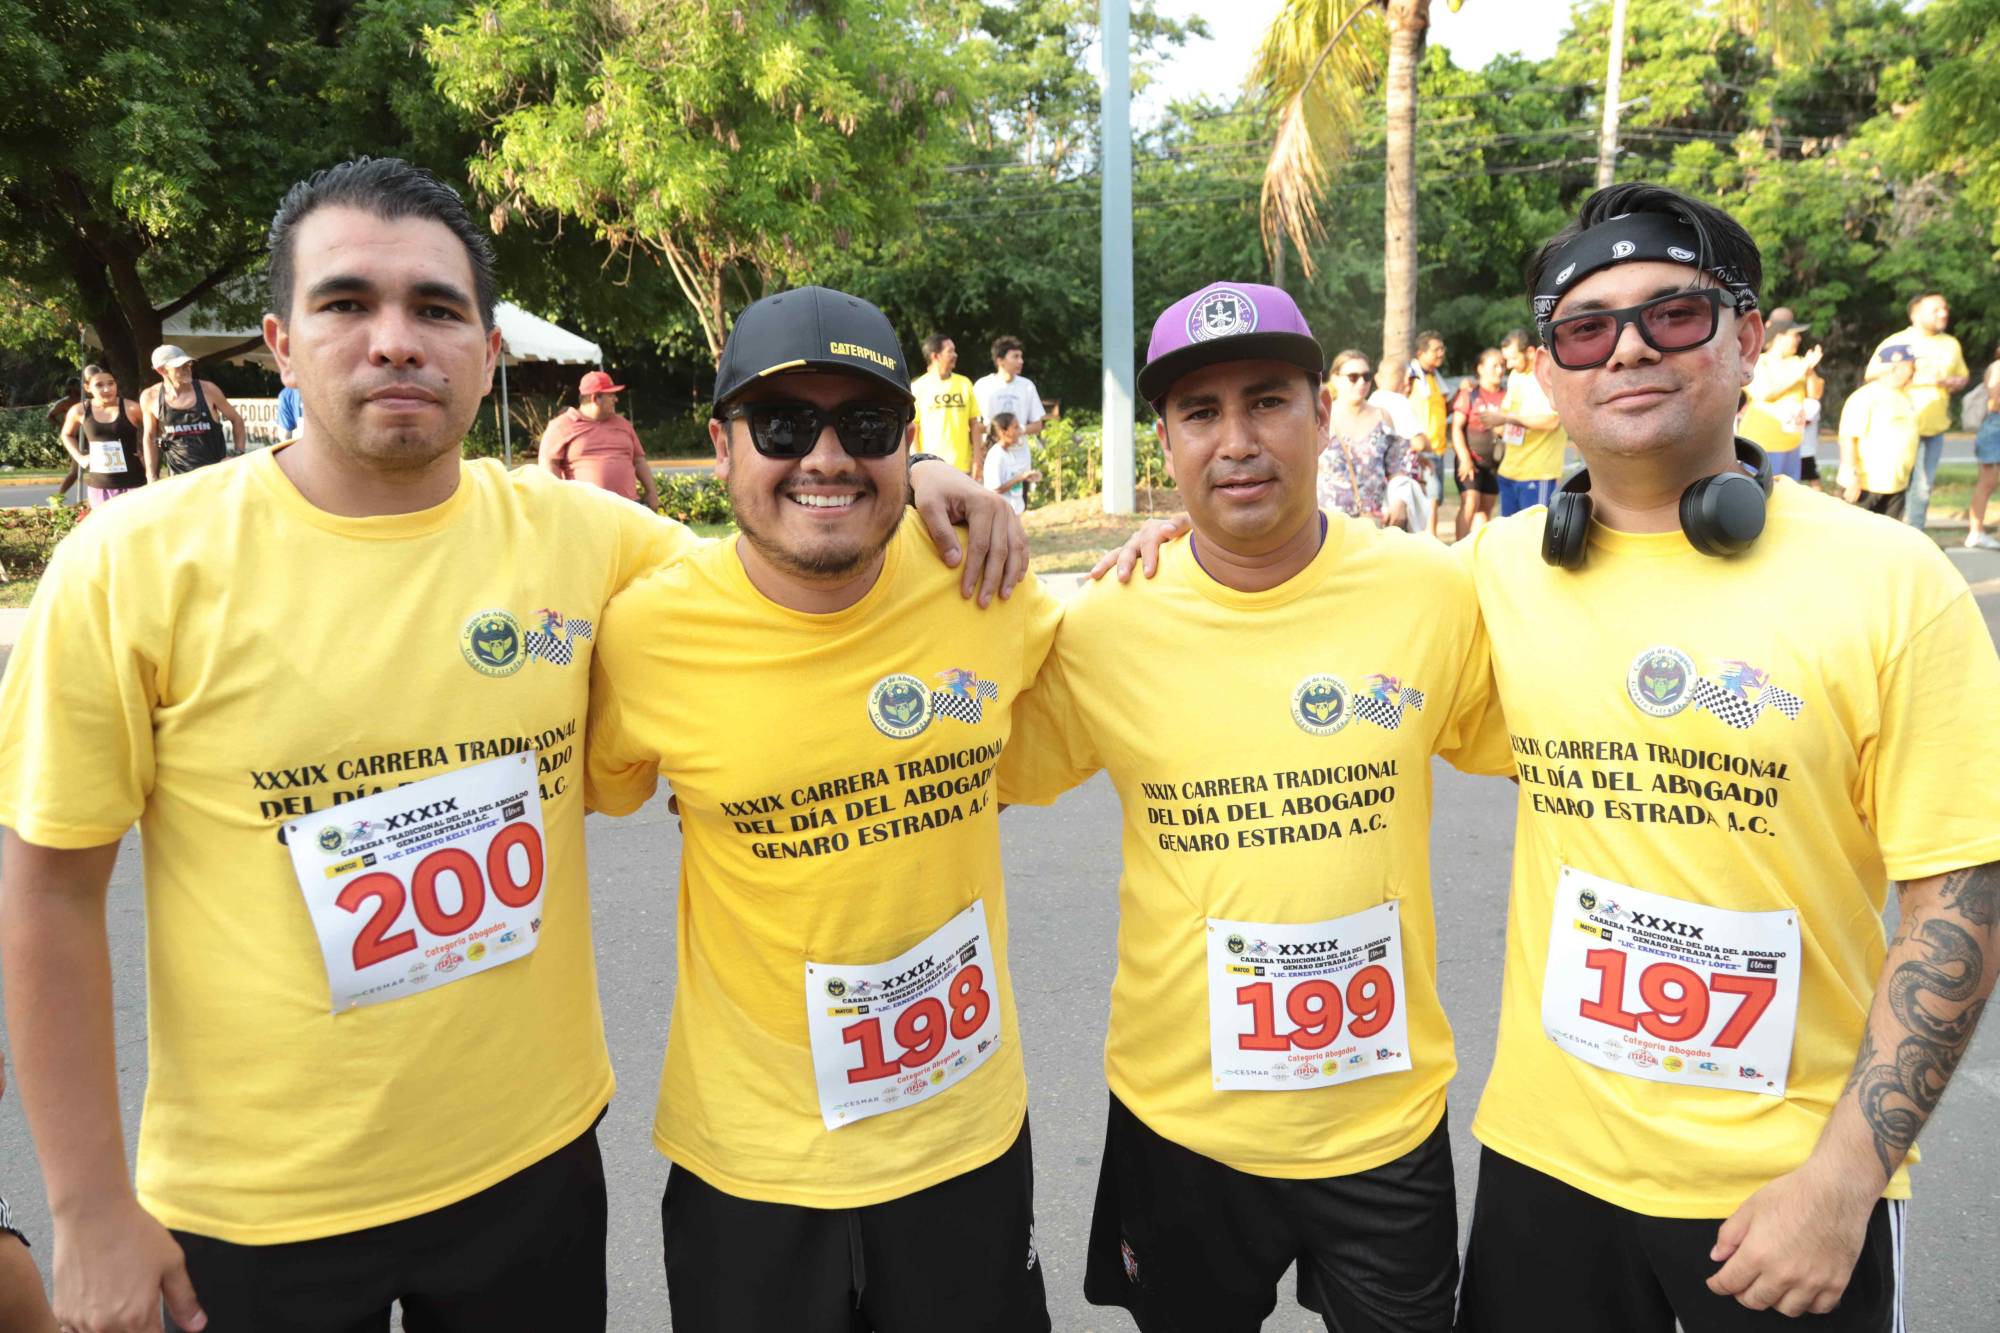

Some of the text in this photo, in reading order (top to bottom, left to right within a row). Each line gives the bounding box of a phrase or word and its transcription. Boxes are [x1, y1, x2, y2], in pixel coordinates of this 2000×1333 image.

[830, 341, 897, 371] CATERPILLAR
[251, 764, 328, 790] XXXIX
[337, 746, 449, 780] CARRERA
[1545, 740, 1638, 761] CARRERA
[1645, 743, 1791, 781] TRADICIONAL
[720, 794, 784, 816] XXXIX
[791, 768, 890, 806] CARRERA
[1141, 760, 1399, 800] XXXIX CARRERA TRADICIONAL
[1547, 765, 1583, 788] DÍA
[1592, 770, 1643, 792] DEL
[1651, 773, 1778, 808] ABOGADO
[260, 796, 321, 819] DEL
[385, 797, 459, 831] XXXIX
[733, 763, 996, 834] DEL DÍA DEL ABOGAD
[1148, 786, 1395, 826] DEL DÍA DEL ABOGADO
[341, 839, 384, 857] CARRERA
[386, 820, 445, 844] TRADICIONAL
[446, 813, 463, 824] DEL
[478, 803, 493, 815] DEL
[495, 790, 529, 809] ABOGADO
[1528, 792, 1775, 837] ENARO ESTRADA A.C.
[396, 831, 432, 849] GENARO
[434, 821, 473, 838] ESTRADA
[405, 837, 445, 855] ERNESTO
[446, 829, 472, 844] KELLY
[751, 832, 850, 860] GENARO
[858, 805, 964, 847] ESTRADA
[1159, 814, 1387, 852] GENARO ESTRADA A.C.
[335, 821, 544, 971] 200
[468, 921, 506, 942] Abogados
[1589, 914, 1624, 930] CARRERA
[1626, 926, 1684, 946] TRADICIONAL
[1686, 940, 1702, 950] DEL
[1722, 947, 1739, 955] DEL
[1741, 950, 1787, 958] ABOGADO
[1631, 911, 1704, 940] XXXIX
[1240, 956, 1274, 964] CARRERA
[1276, 956, 1325, 964] TRADICIONAL
[1326, 953, 1338, 961] DEL
[1352, 945, 1363, 954] DEL
[1363, 936, 1391, 950] ABOGADO
[1278, 939, 1339, 956] XXXIX
[1632, 935, 1668, 950] GENARO
[1670, 945, 1712, 958] ESTRADA
[1637, 945, 1677, 959] ERNESTO
[1678, 954, 1707, 966] KELLY
[842, 995, 878, 1004] CARRERA
[880, 977, 925, 1000] TRADICIONAL
[925, 969, 937, 979] DEL
[945, 955, 955, 965] DEL
[955, 934, 980, 956] ABOGADO
[881, 955, 936, 991] XXXIX
[1288, 970, 1321, 978] ERNESTO
[1322, 966, 1343, 975] KELLY
[1315, 958, 1346, 968] ESTRADA
[362, 978, 405, 996] CESMAR
[887, 987, 915, 1003] GENARO
[916, 972, 944, 991] ESTRADA
[893, 991, 923, 1008] ERNESTO
[924, 980, 941, 994] KELLY
[1579, 948, 1778, 1049] 197
[1236, 965, 1395, 1051] 199
[842, 964, 990, 1084] 198
[1325, 1046, 1357, 1058] Abogados
[1563, 1033, 1600, 1049] CESMAR
[1669, 1045, 1712, 1058] Abogados
[932, 1049, 961, 1068] Abogados
[844, 1097, 879, 1108] CESMAR
